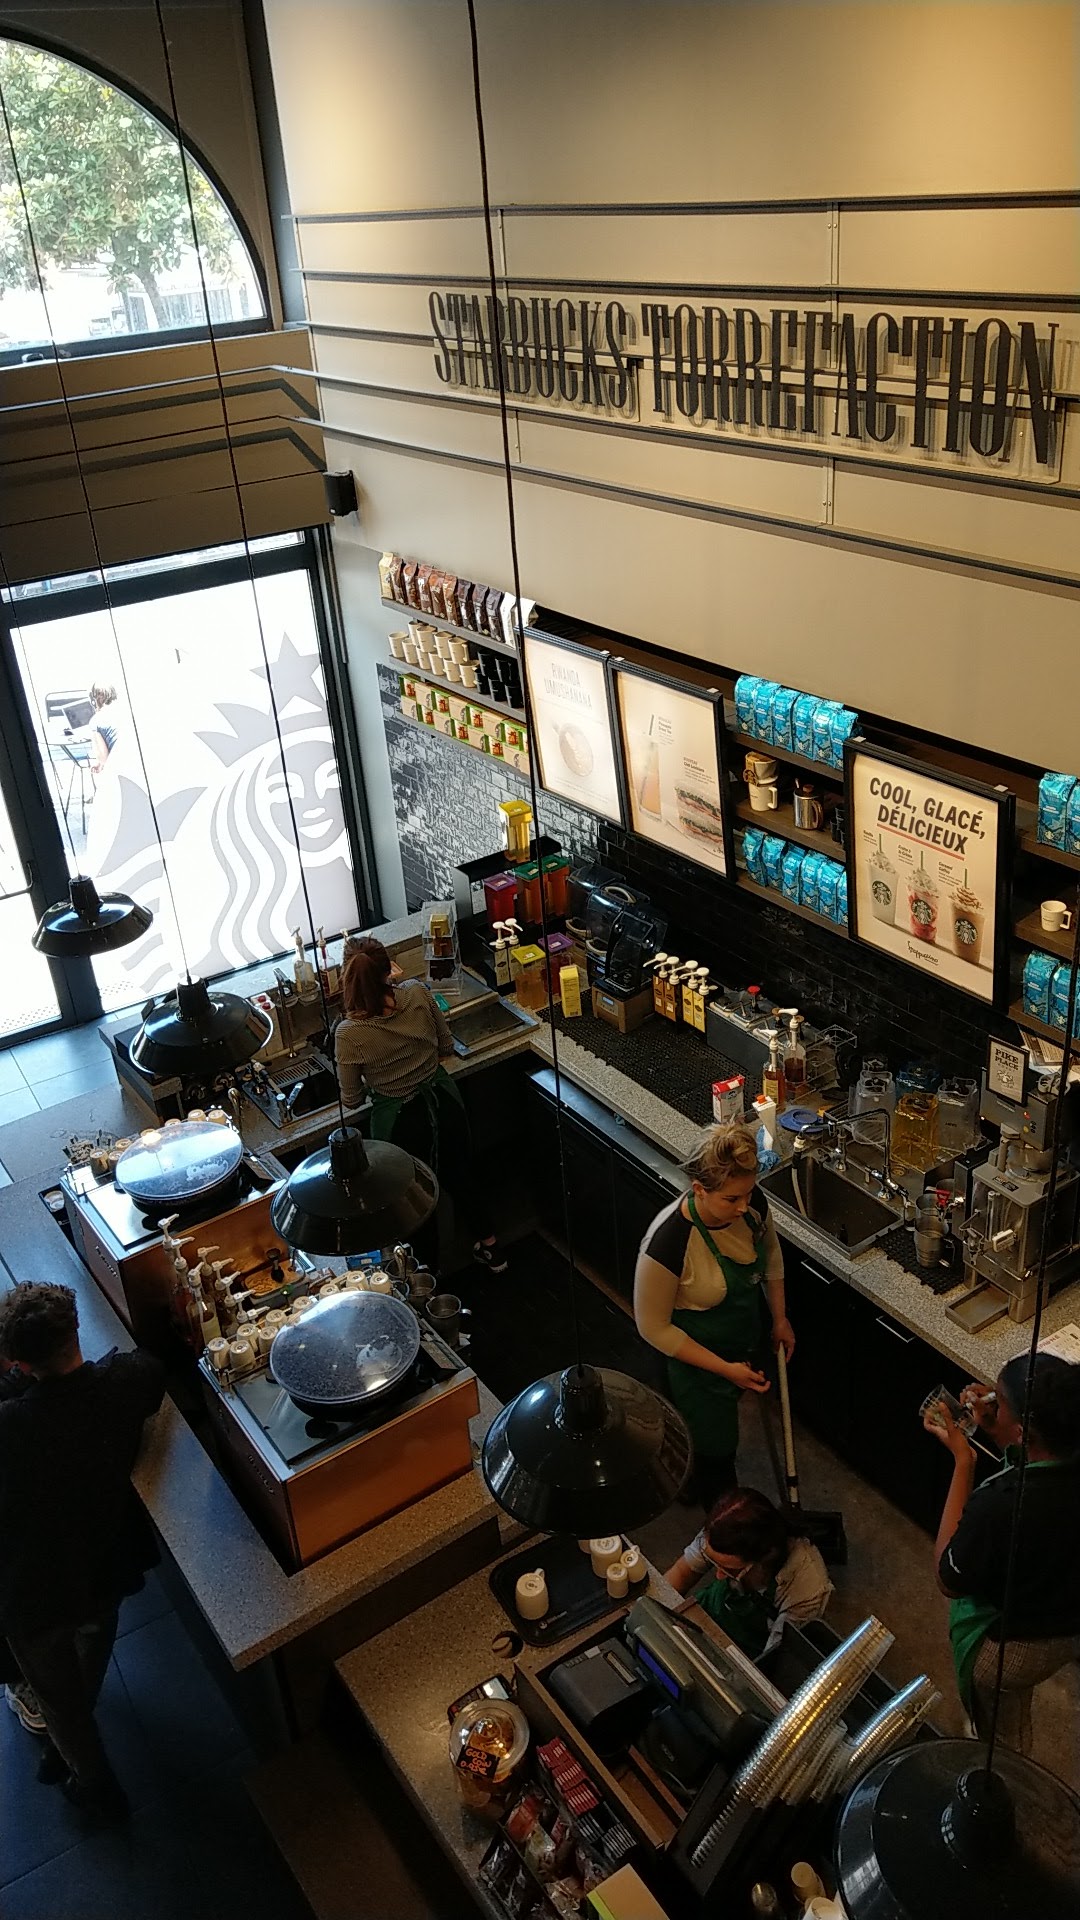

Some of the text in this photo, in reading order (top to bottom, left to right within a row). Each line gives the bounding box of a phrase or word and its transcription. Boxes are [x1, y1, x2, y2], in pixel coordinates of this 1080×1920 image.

[428, 291, 1060, 464] STARBUCKS TORREFACTION
[869, 776, 987, 839] COOL, GLACÉ,
[876, 804, 969, 855] DÉLICIEUX
[994, 1055, 1019, 1071] PLACE
[995, 1048, 1019, 1065] PIKE
[466, 1748, 488, 1760] GOLD
